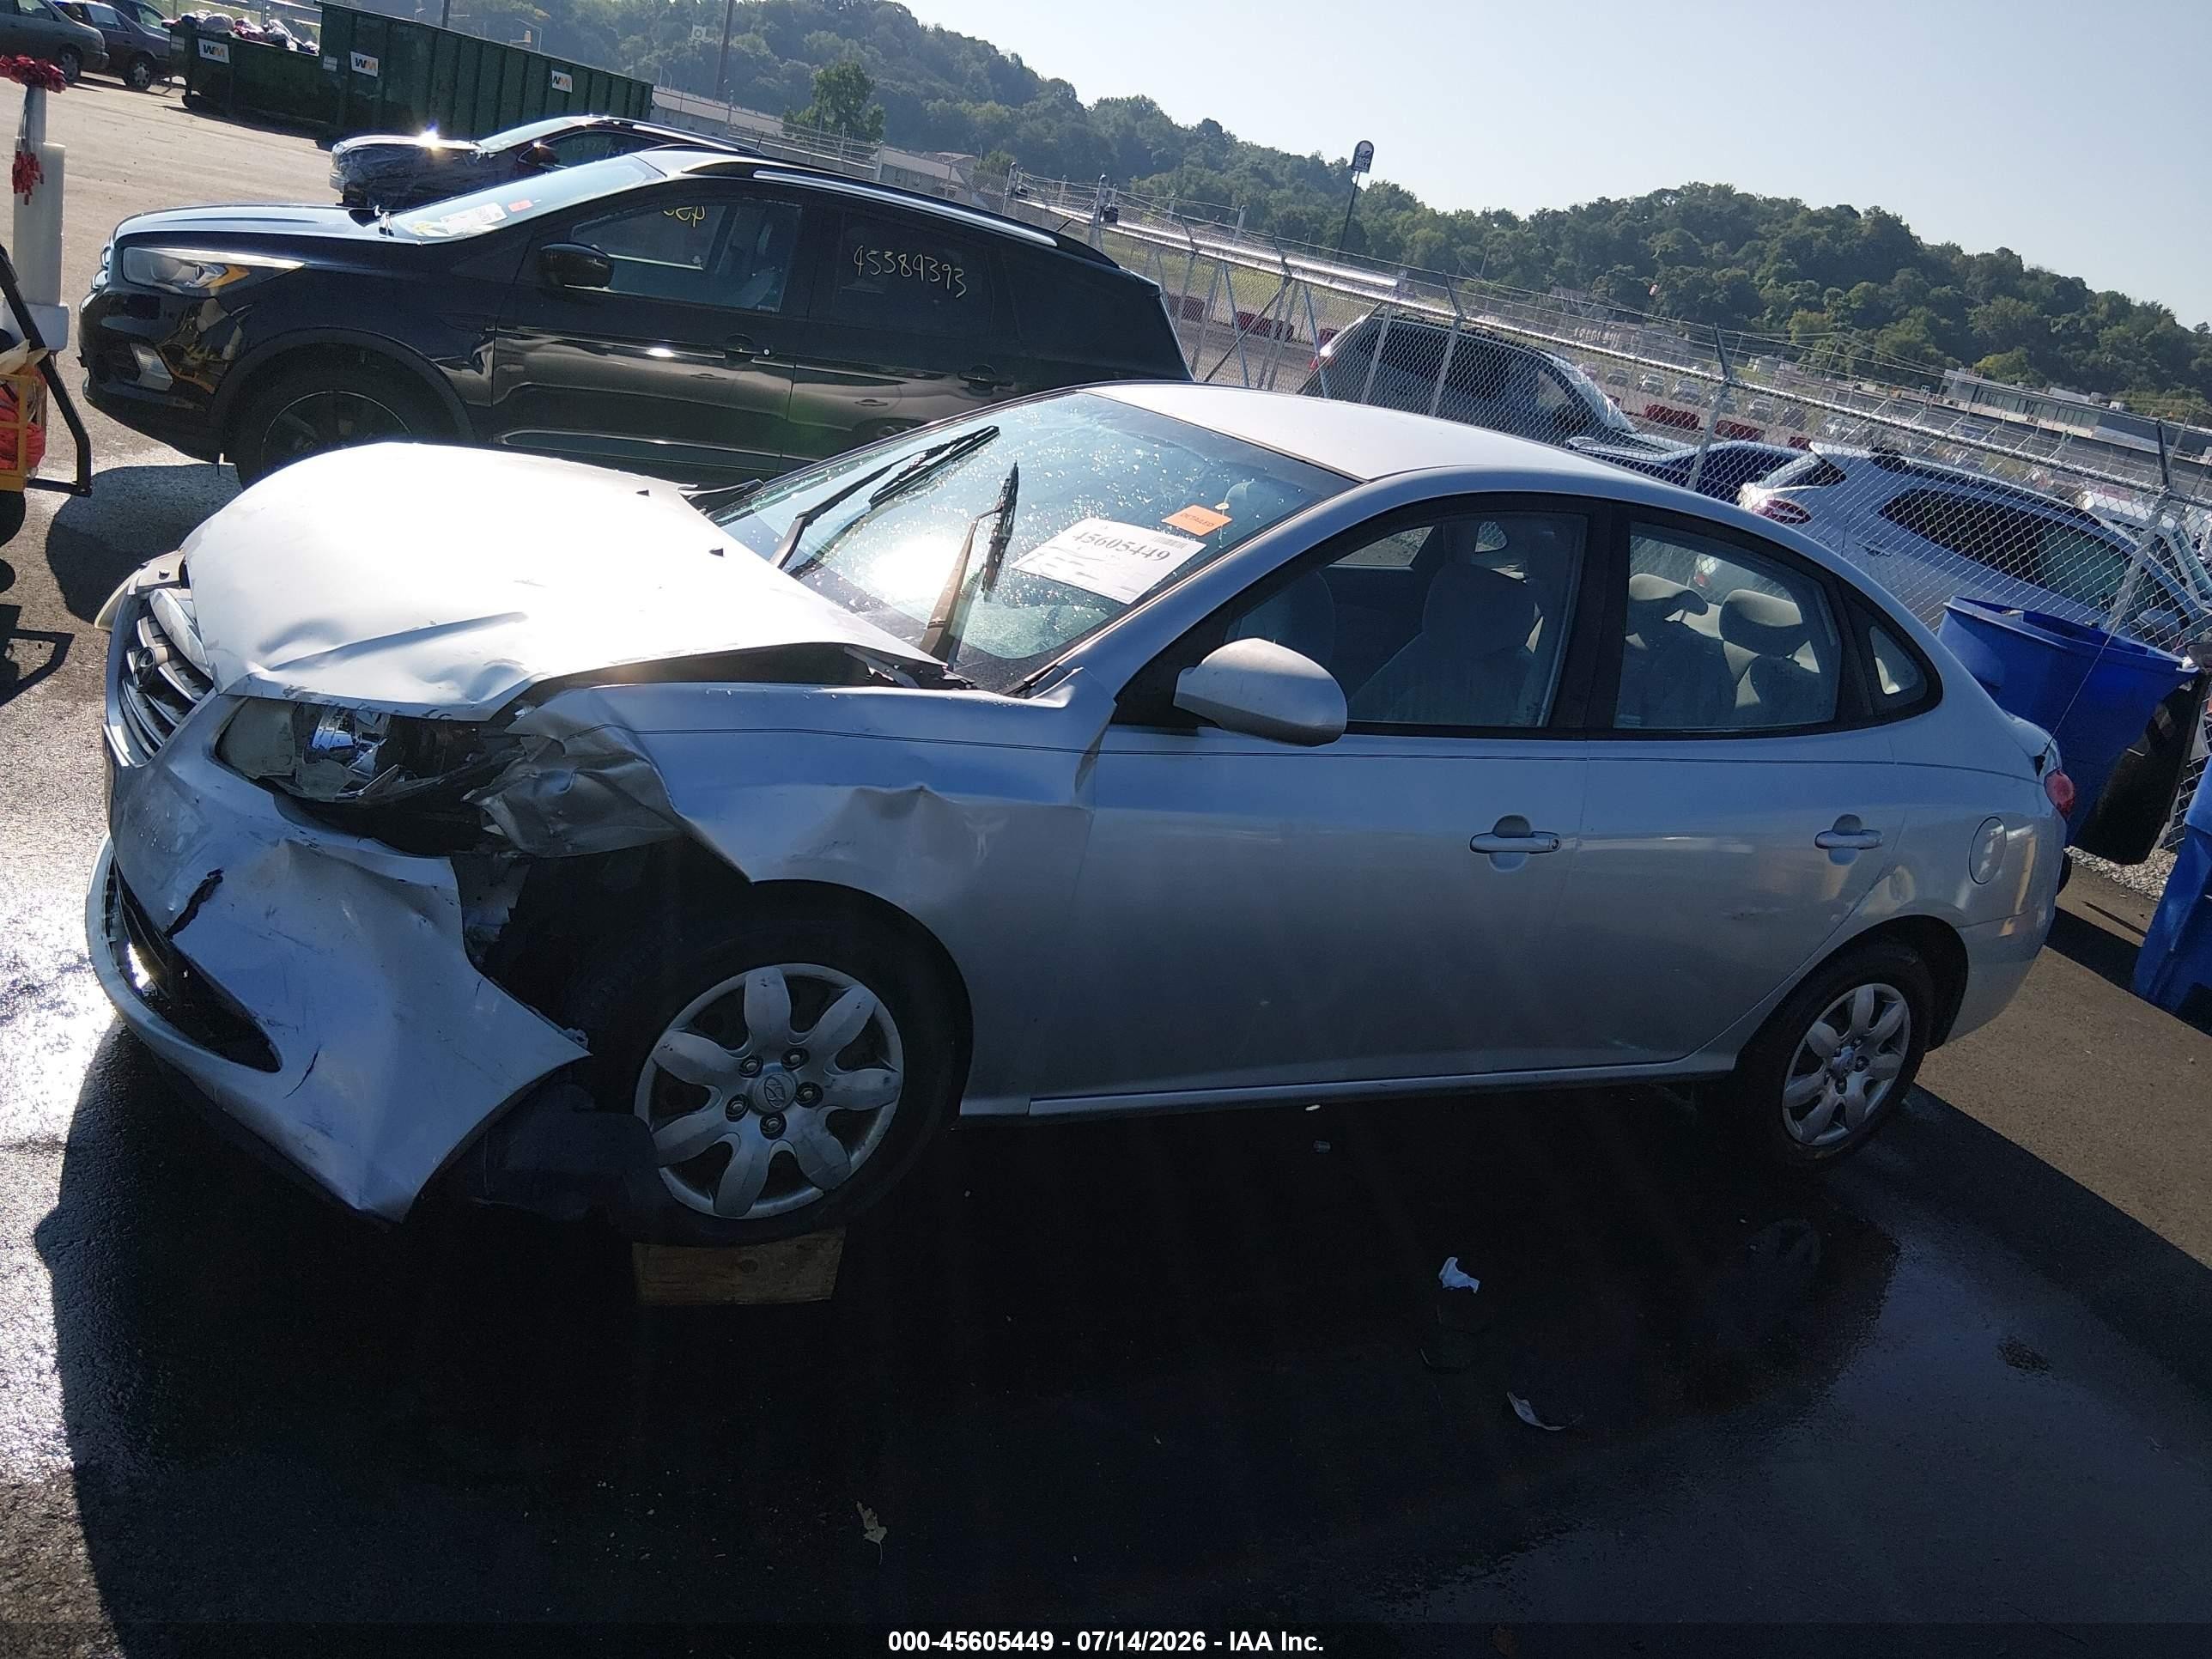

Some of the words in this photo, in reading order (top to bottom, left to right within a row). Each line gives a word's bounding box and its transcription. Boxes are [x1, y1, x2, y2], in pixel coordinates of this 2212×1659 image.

[203, 44, 225, 58] WM
[355, 57, 377, 70] WM
[1180, 513, 1216, 528] DETAILED
[1073, 532, 1170, 561] 45605449
